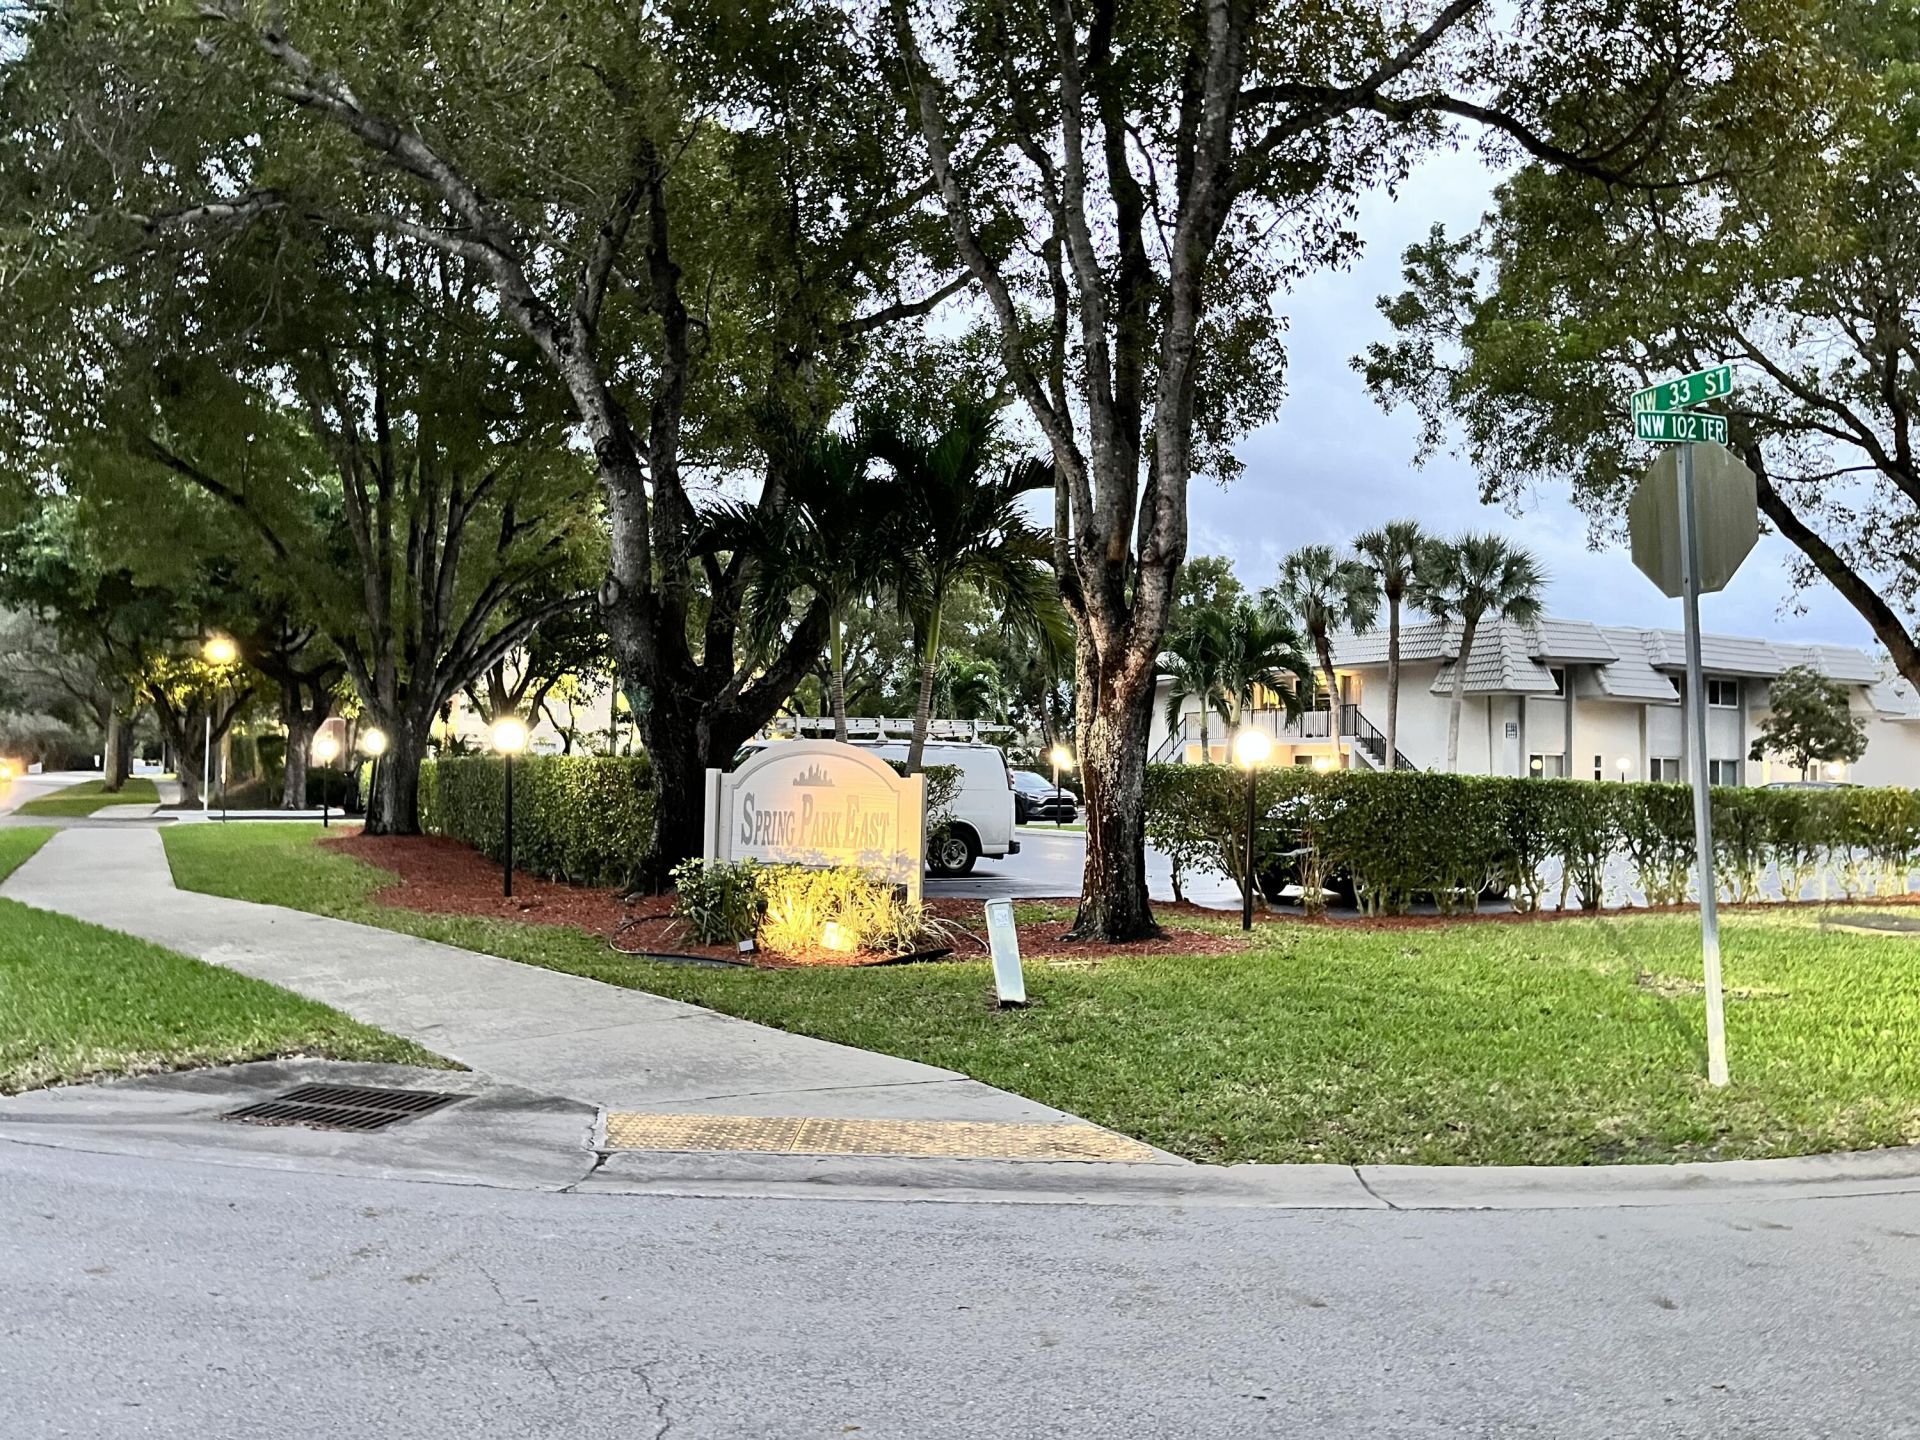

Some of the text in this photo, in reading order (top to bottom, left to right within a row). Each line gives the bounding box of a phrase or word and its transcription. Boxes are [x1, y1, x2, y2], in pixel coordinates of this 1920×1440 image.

[1634, 368, 1727, 411] NW 33 ST
[1640, 414, 1725, 443] NW 102 TER
[740, 791, 890, 850] SPRING PARK EAST
